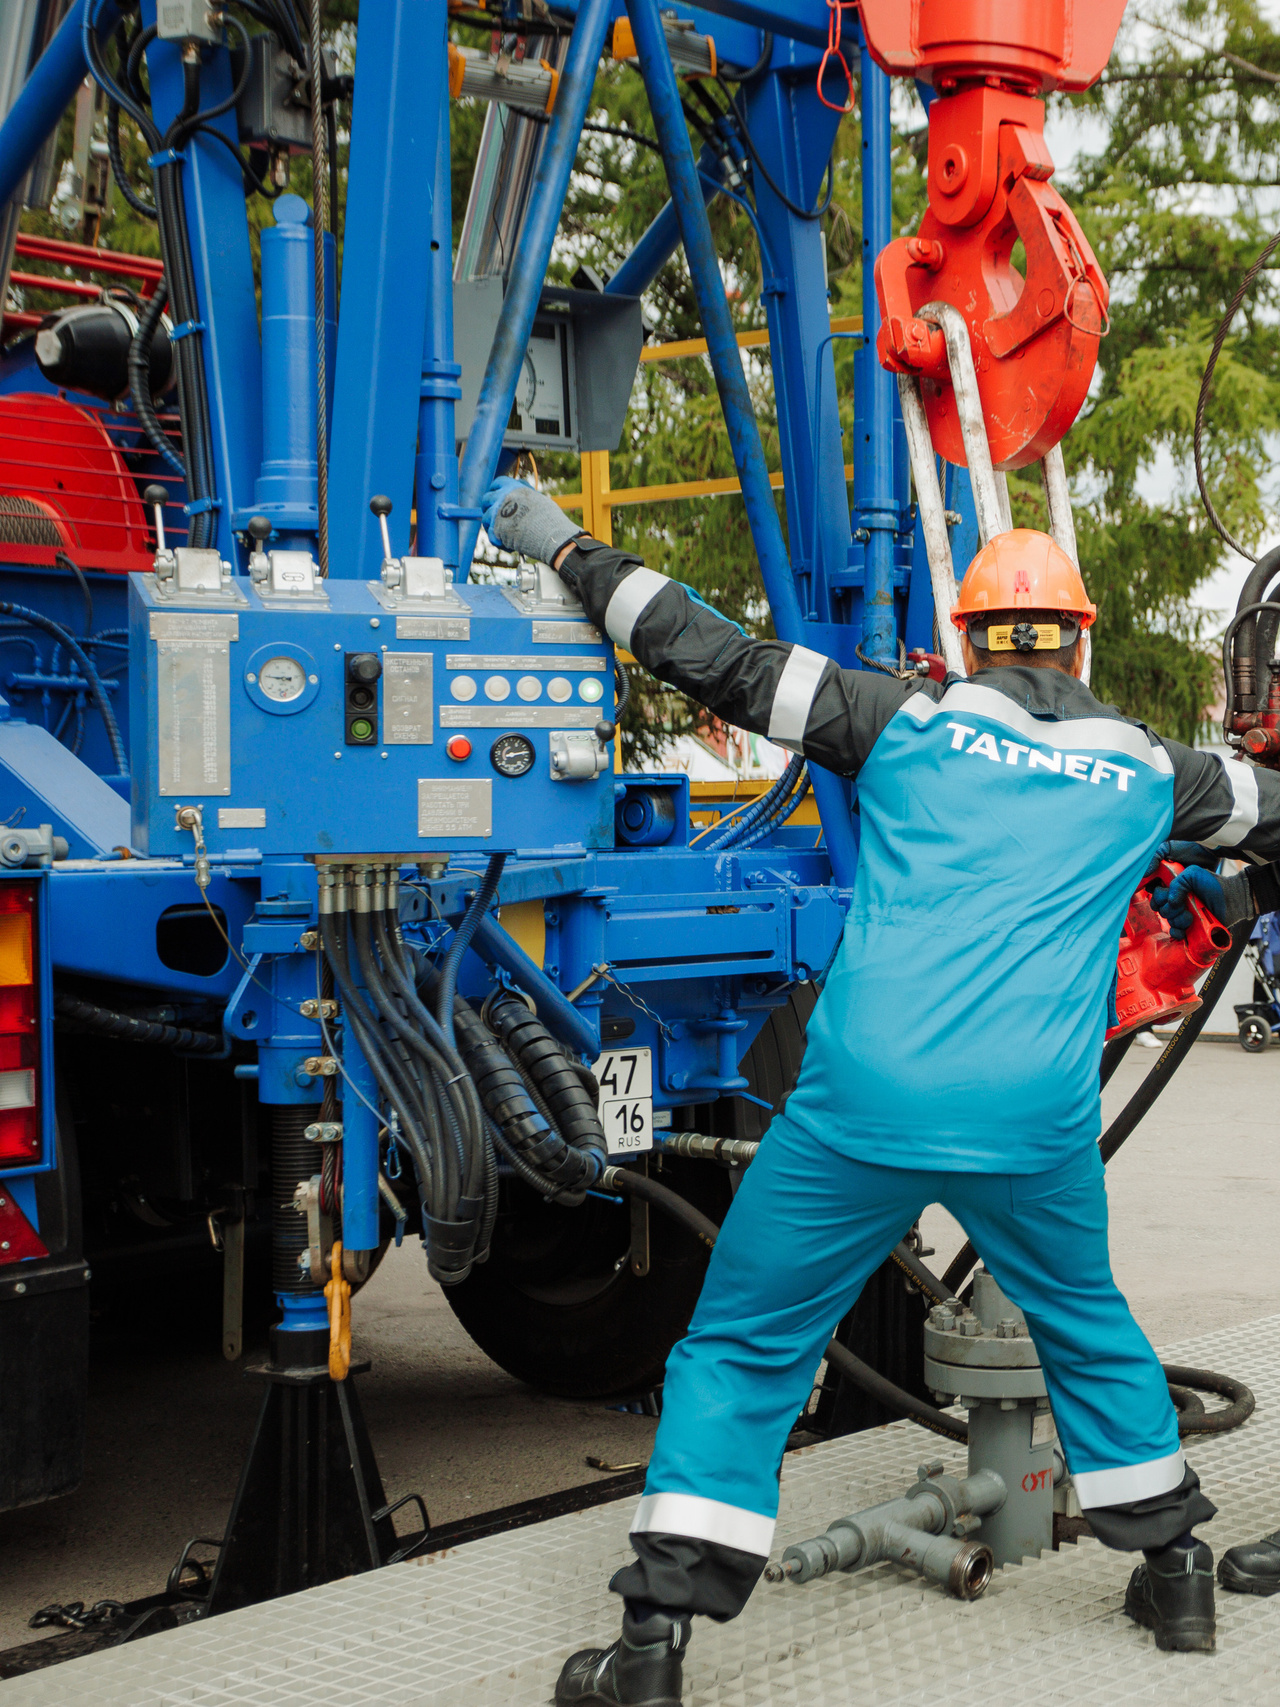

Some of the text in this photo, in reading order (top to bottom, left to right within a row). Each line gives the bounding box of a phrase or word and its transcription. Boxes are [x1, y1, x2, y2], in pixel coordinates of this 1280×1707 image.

[385, 657, 429, 666] ЭКСТРЕННЫЙ
[390, 665, 421, 673] ОСТАНОВ
[391, 695, 419, 703] СИГНАЛ
[391, 724, 422, 732] ВОЗВРАТ
[946, 722, 1136, 792] TATNEFT
[1160, 1036, 1179, 1063] SVAROG
[1177, 1025, 1186, 1037] EN
[1203, 980, 1212, 991] DN
[600, 1055, 637, 1096] 47
[615, 1103, 645, 1135] 16
[618, 1135, 642, 1149] RUS
[912, 1275, 922, 1286] EN
